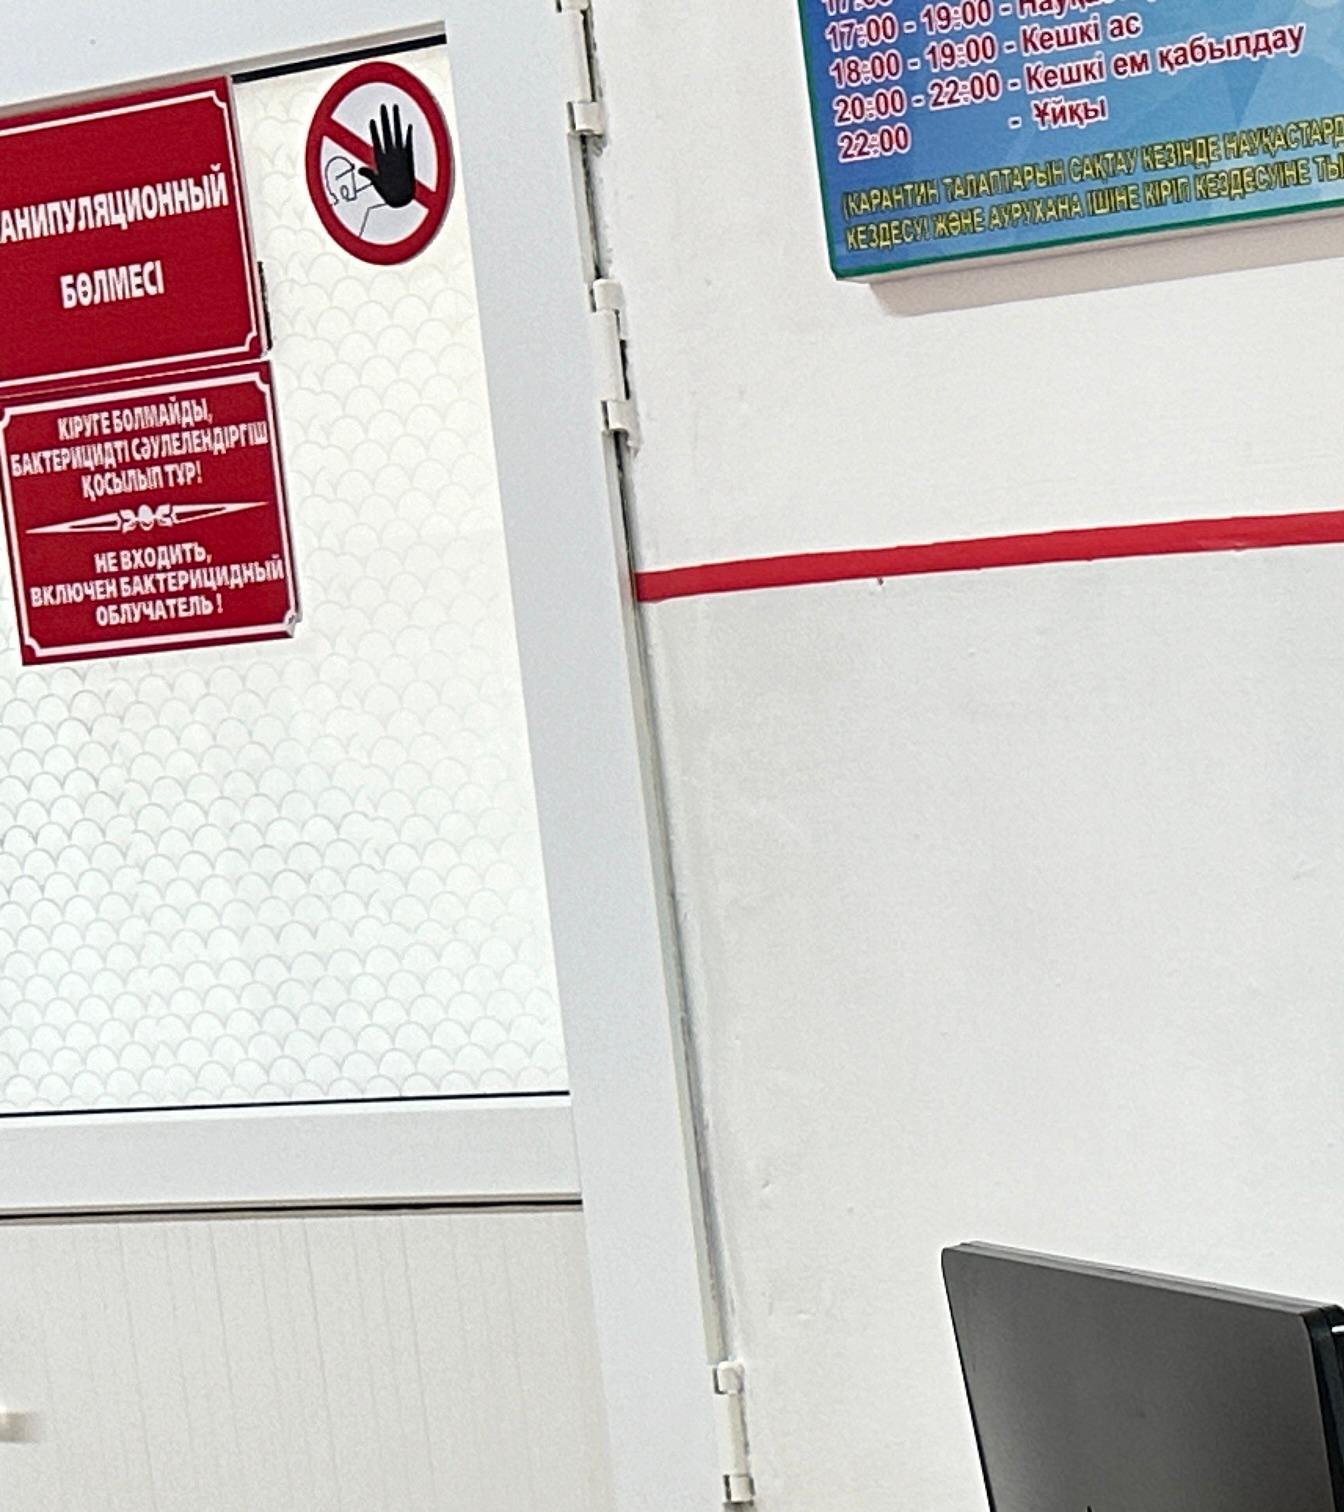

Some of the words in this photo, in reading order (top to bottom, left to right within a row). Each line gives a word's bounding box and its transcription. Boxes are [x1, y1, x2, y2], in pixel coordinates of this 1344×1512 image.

[825, 17, 899, 51] 17:00
[920, 0, 992, 35] 19:00
[830, 53, 900, 88] 18:00
[925, 35, 997, 71] 19:00
[1021, 15, 1101, 55] Кешкі
[1111, 11, 1143, 40] ас
[834, 90, 906, 126] 20:00
[929, 72, 1001, 107] 22:00
[1025, 56, 1106, 93] Кешкі
[1113, 51, 1150, 77] ем
[1158, 24, 1306, 71] қабылдау
[838, 127, 910, 162] 22:00
[934, 207, 992, 237] ЖӘНЕ
[989, 193, 1084, 229] АУРУХАНА
[60, 261, 164, 309] БӨЛМЕСІ
[57, 411, 111, 440] КІРУГЕ
[112, 396, 213, 433] БОЛМАЙДЫ,
[10, 440, 130, 477] БАКТЕРИЦИДТІ
[131, 421, 268, 460] СӘУЛЕЛЕНДІРГІШ
[81, 467, 163, 501] ҚОСЫЛЫП
[94, 550, 119, 574] НЕ
[120, 542, 213, 571] ВХОДИТЬ,
[30, 580, 118, 608] ВКЛЮЧЕН
[119, 560, 285, 599] БАКТЕРИЦИДНЫЙ
[96, 597, 213, 627] ОБЛУЧАТЕЛЬ
